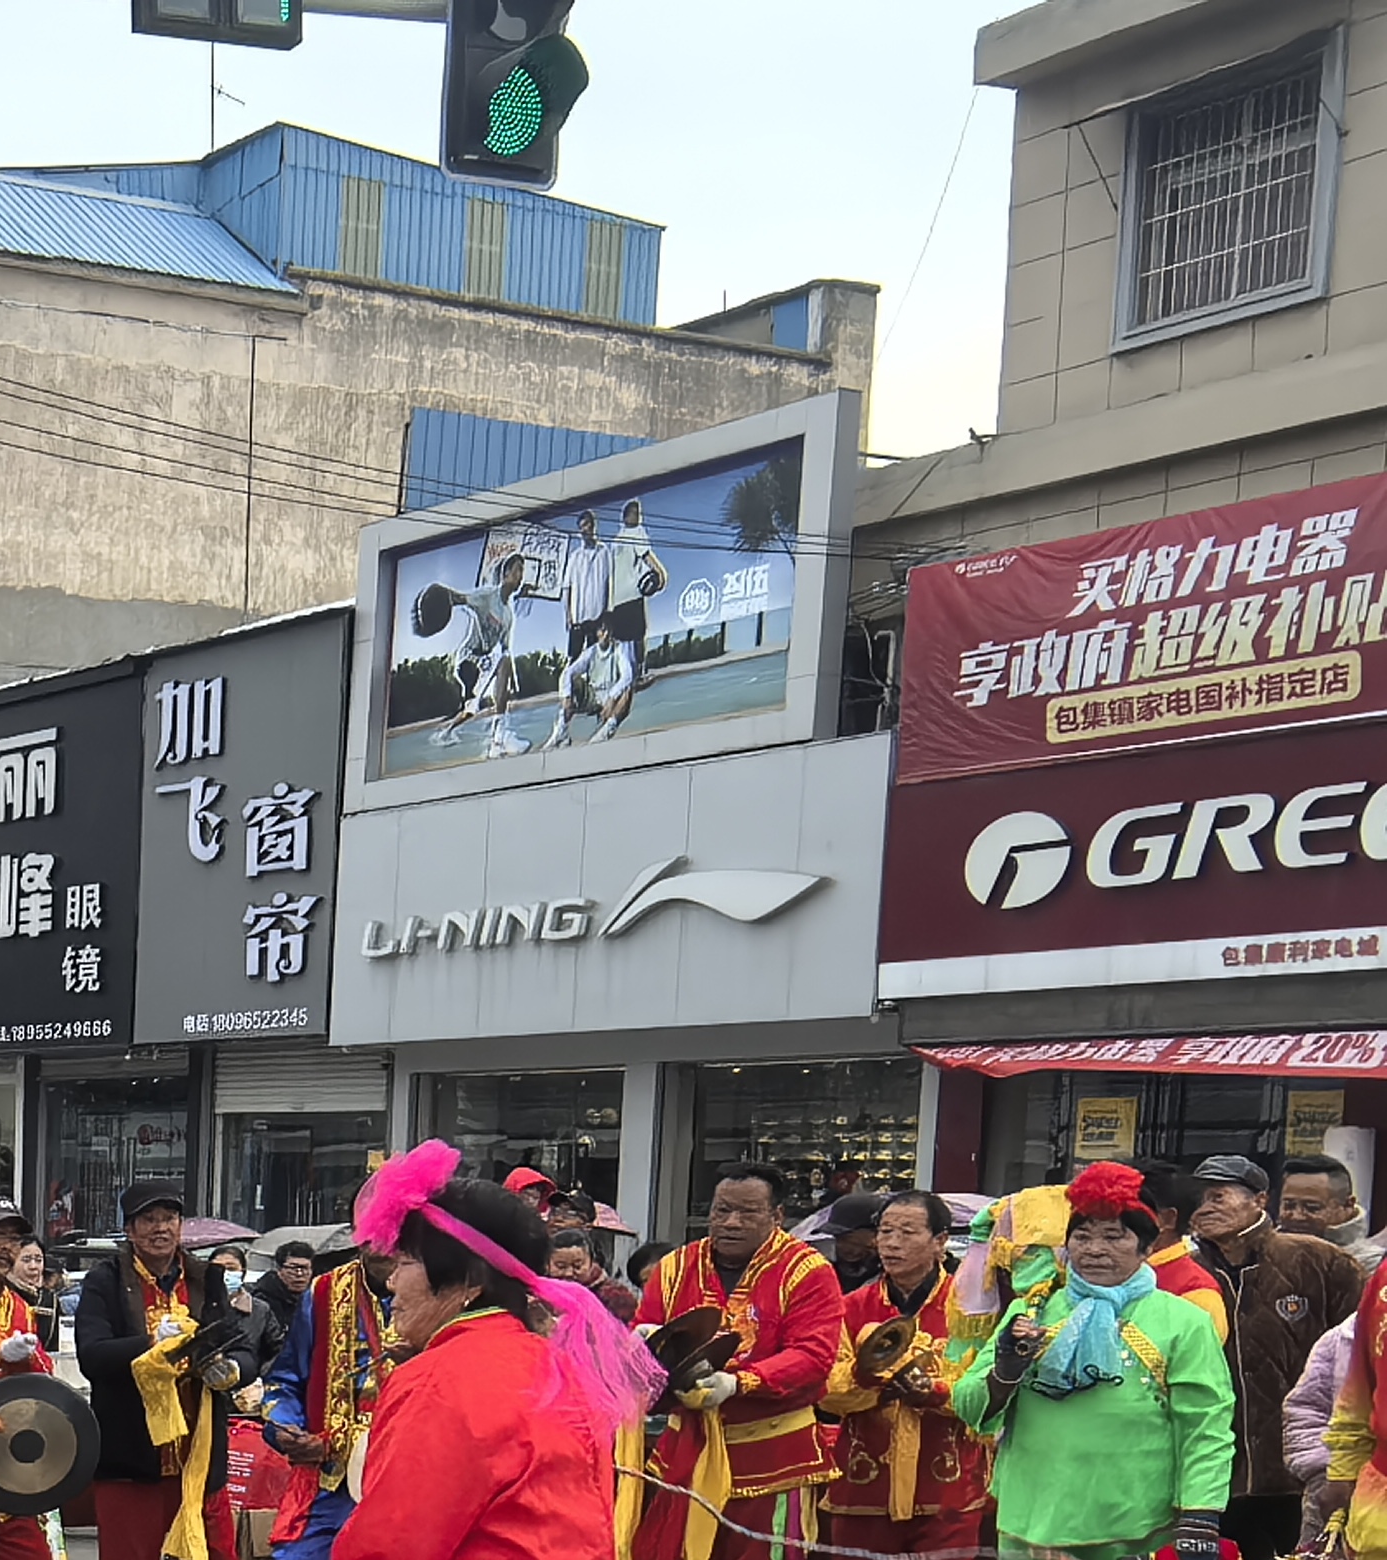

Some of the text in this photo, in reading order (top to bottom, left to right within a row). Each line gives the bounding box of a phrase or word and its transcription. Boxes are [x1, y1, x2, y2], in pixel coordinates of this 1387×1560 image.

[1067, 506, 1360, 618] 买格力电器
[953, 570, 1387, 708] 享政府超级补贴
[1054, 662, 1350, 733] 包集镇家电国补指定店
[154, 676, 230, 866] 加飞
[61, 881, 103, 994] 眼镜
[241, 781, 325, 983] 窗帘
[360, 896, 597, 962] LI-NING
